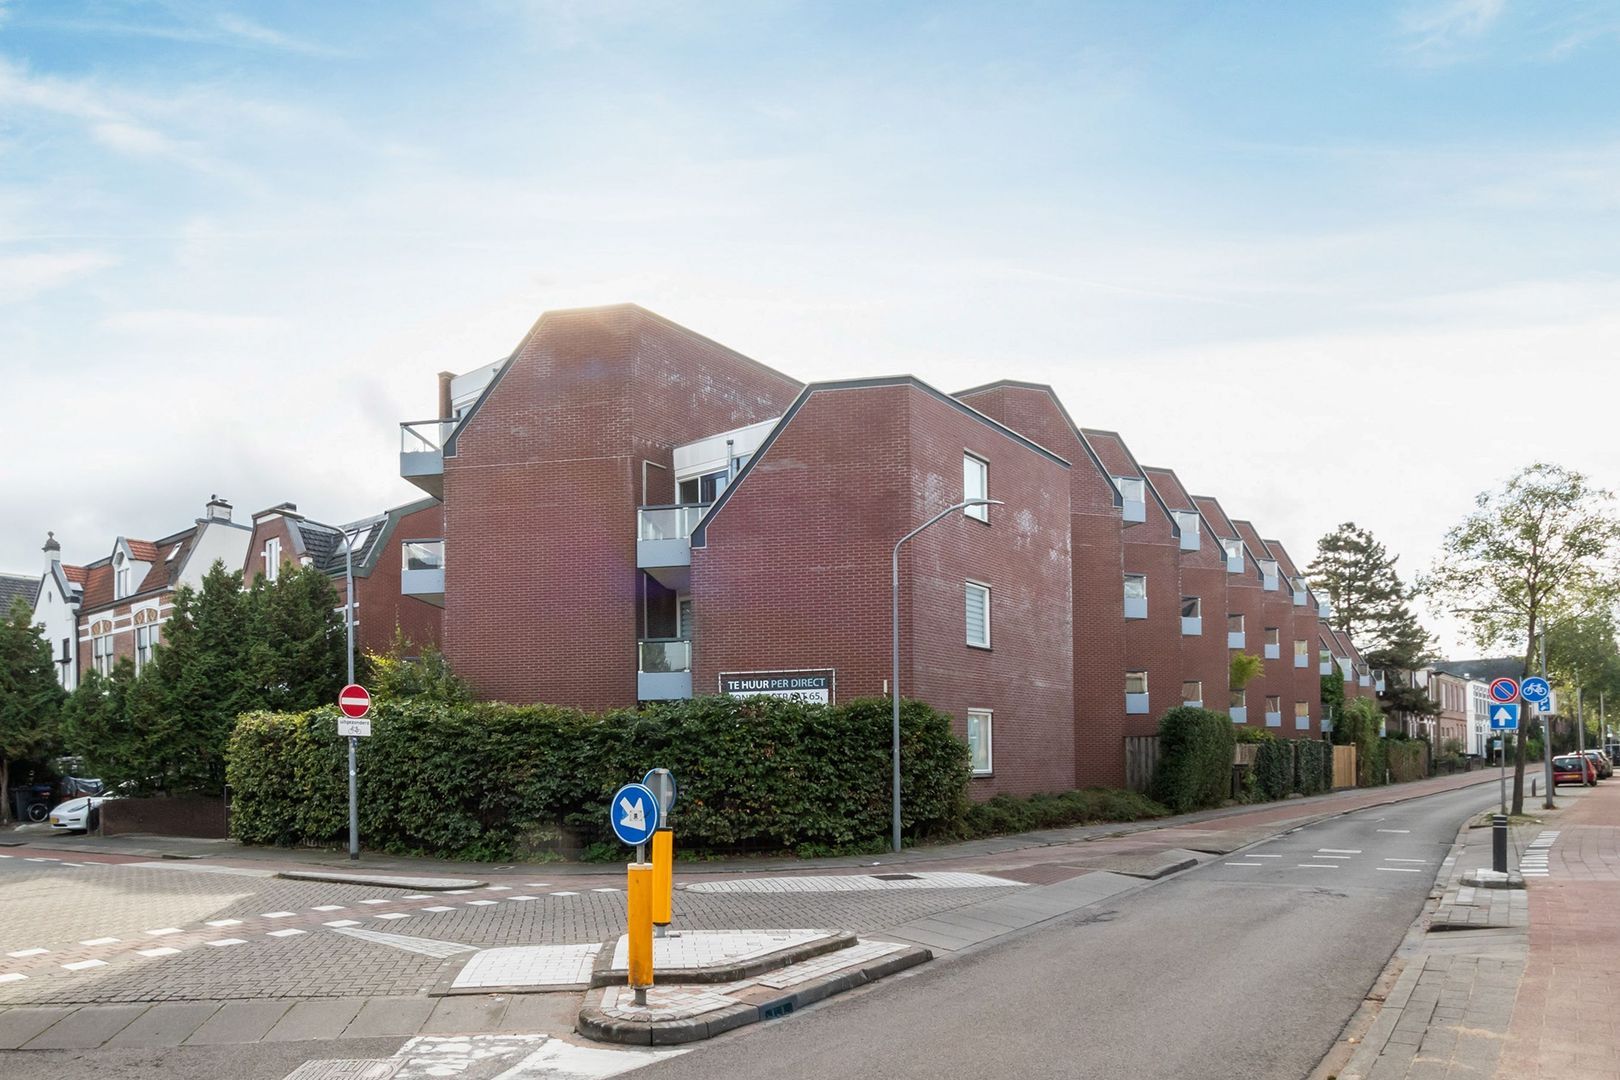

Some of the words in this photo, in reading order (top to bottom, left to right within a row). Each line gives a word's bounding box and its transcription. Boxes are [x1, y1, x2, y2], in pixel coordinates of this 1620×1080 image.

[727, 681, 740, 690] TE
[741, 680, 769, 690] HUUR
[771, 679, 789, 688] PER
[791, 678, 826, 688] DIRECT
